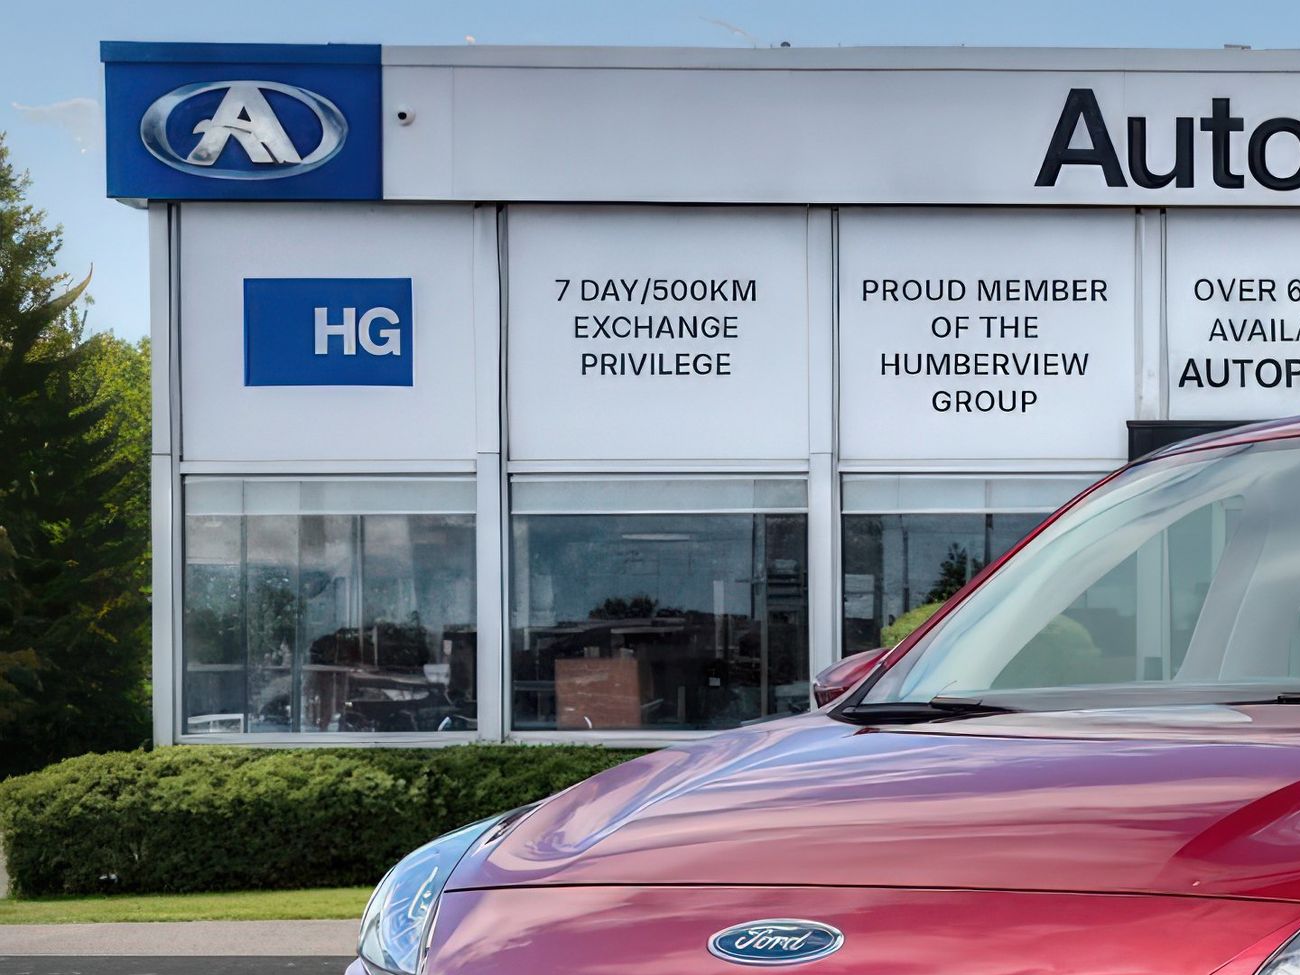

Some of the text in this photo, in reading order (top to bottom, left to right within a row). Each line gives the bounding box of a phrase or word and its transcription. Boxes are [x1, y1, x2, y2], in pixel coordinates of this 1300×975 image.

[555, 278, 757, 304] 7 DAY/500KM
[862, 279, 1108, 302] PROUD MEMBER
[1194, 278, 1277, 302] OVER
[314, 306, 401, 356] HG
[574, 315, 738, 339] EXCHANGE
[931, 315, 1039, 339] OF THE
[581, 352, 731, 376] PRIVILEGE
[881, 352, 1089, 376] HUMBERVIEW
[932, 390, 1038, 413] GROUP
[735, 926, 814, 951] Ford
